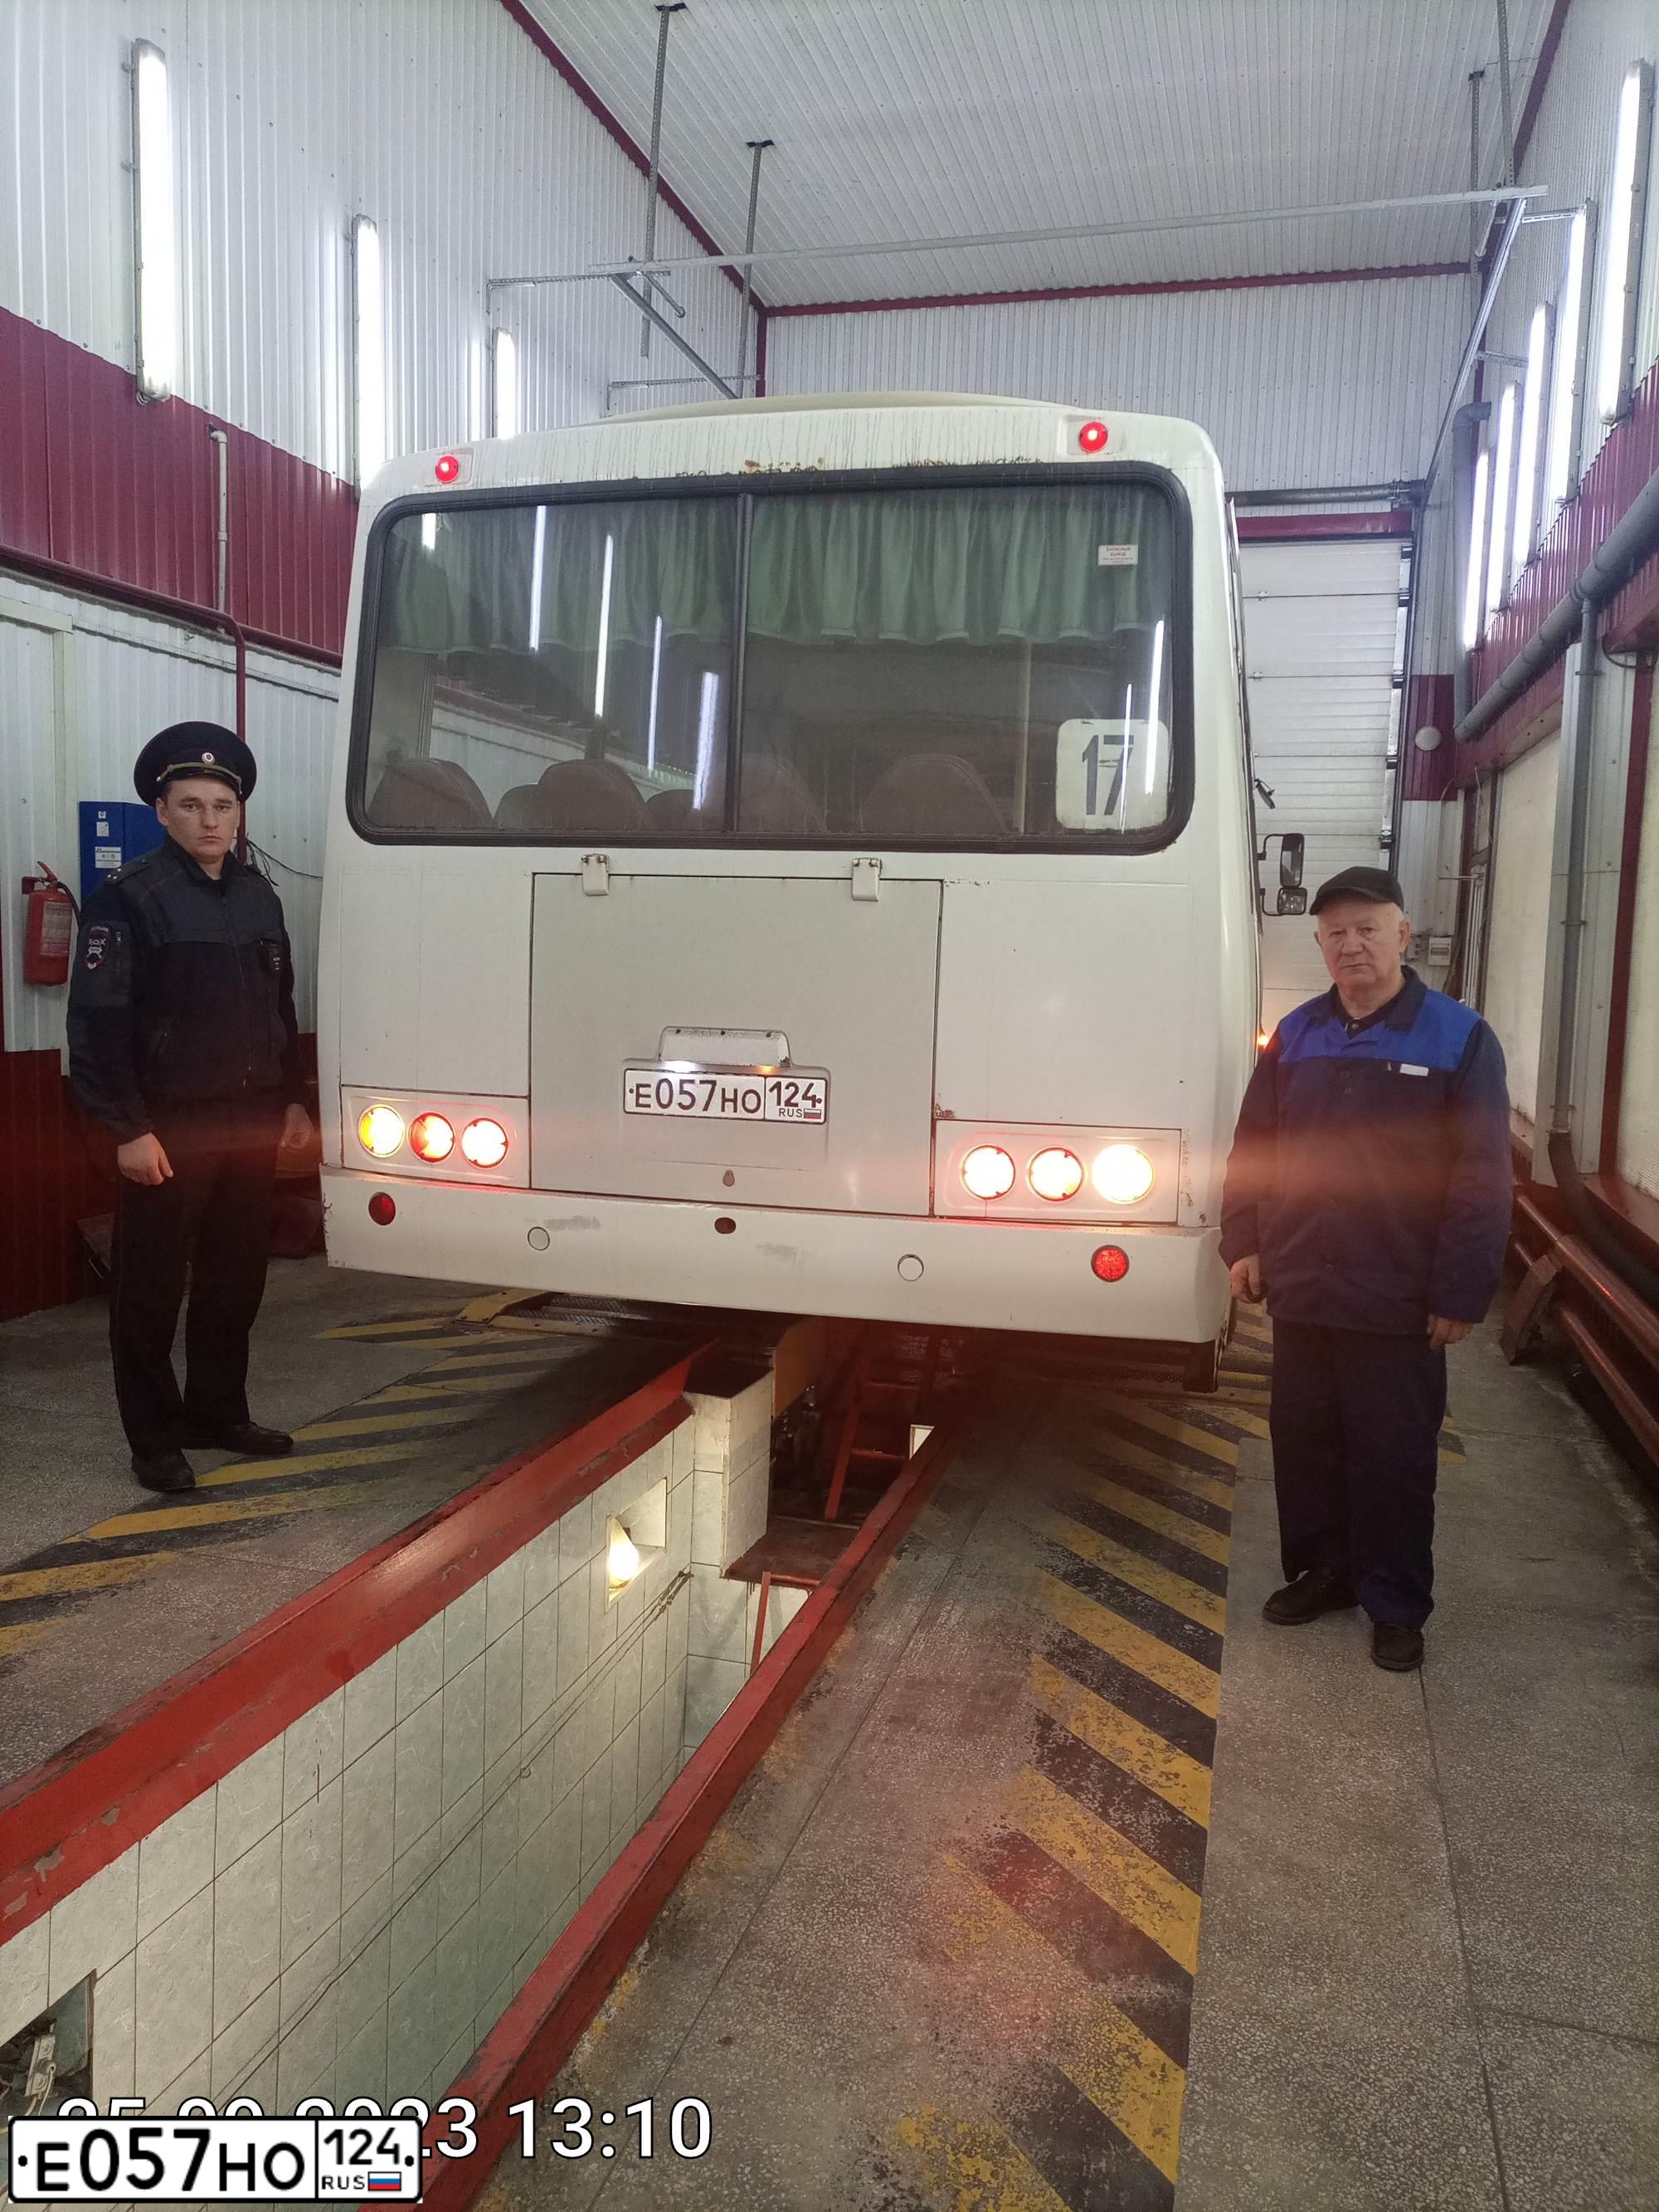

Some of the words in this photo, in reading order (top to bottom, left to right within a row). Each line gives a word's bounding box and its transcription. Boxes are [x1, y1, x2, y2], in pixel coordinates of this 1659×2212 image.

[1082, 735, 1134, 815] 17
[768, 1080, 818, 1108] 124
[778, 1108, 803, 1118] RUS
